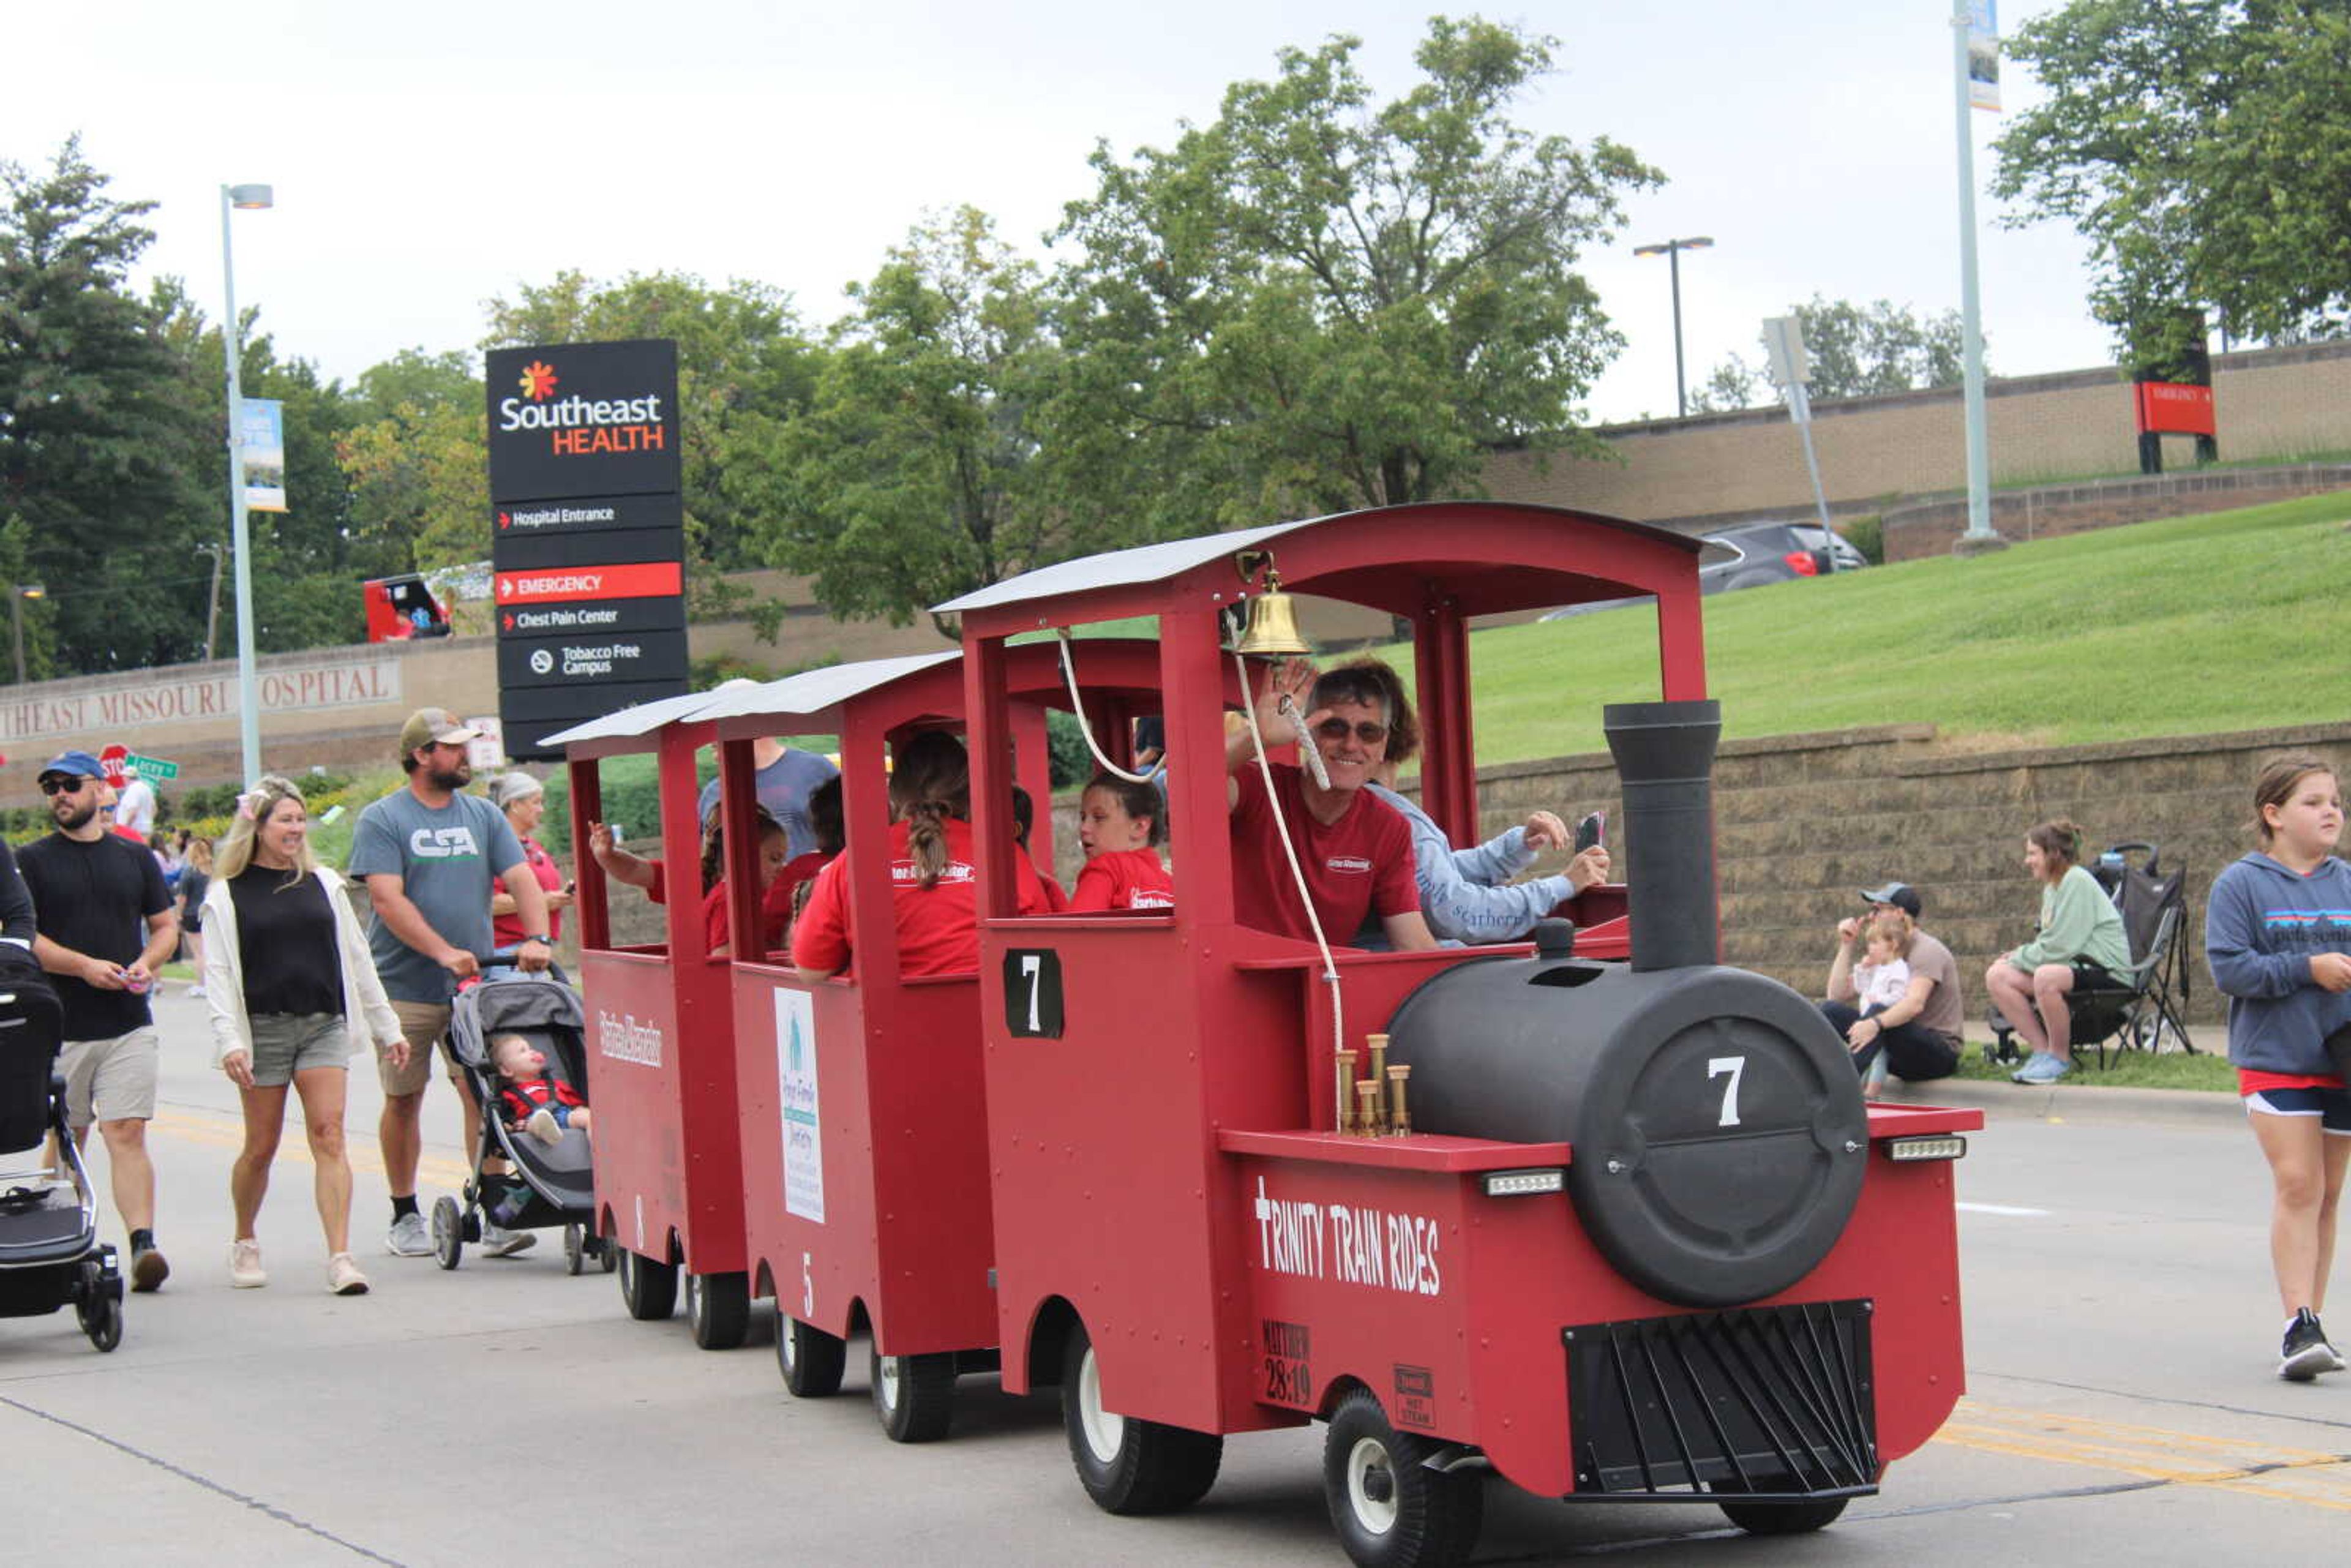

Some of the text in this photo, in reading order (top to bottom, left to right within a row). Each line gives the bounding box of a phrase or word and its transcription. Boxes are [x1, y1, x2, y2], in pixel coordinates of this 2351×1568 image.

[500, 394, 661, 430] Southeast
[553, 425, 664, 455] HEALTH
[514, 508, 613, 528] Hospital Entrance
[518, 576, 602, 595] EMERGENCY
[518, 609, 618, 629] Chest Pain Center
[562, 643, 640, 661] Tobacco Free
[563, 660, 612, 677] Campus
[98, 681, 227, 725] MISSOURI
[262, 666, 388, 707] OSPITAL
[102, 757, 127, 779] STO
[1022, 955, 1040, 1032] 7
[1709, 1056, 1745, 1126] 7
[1255, 1176, 1440, 1296] TRINITY TRAIN RIDES
[803, 1252, 814, 1318] 5
